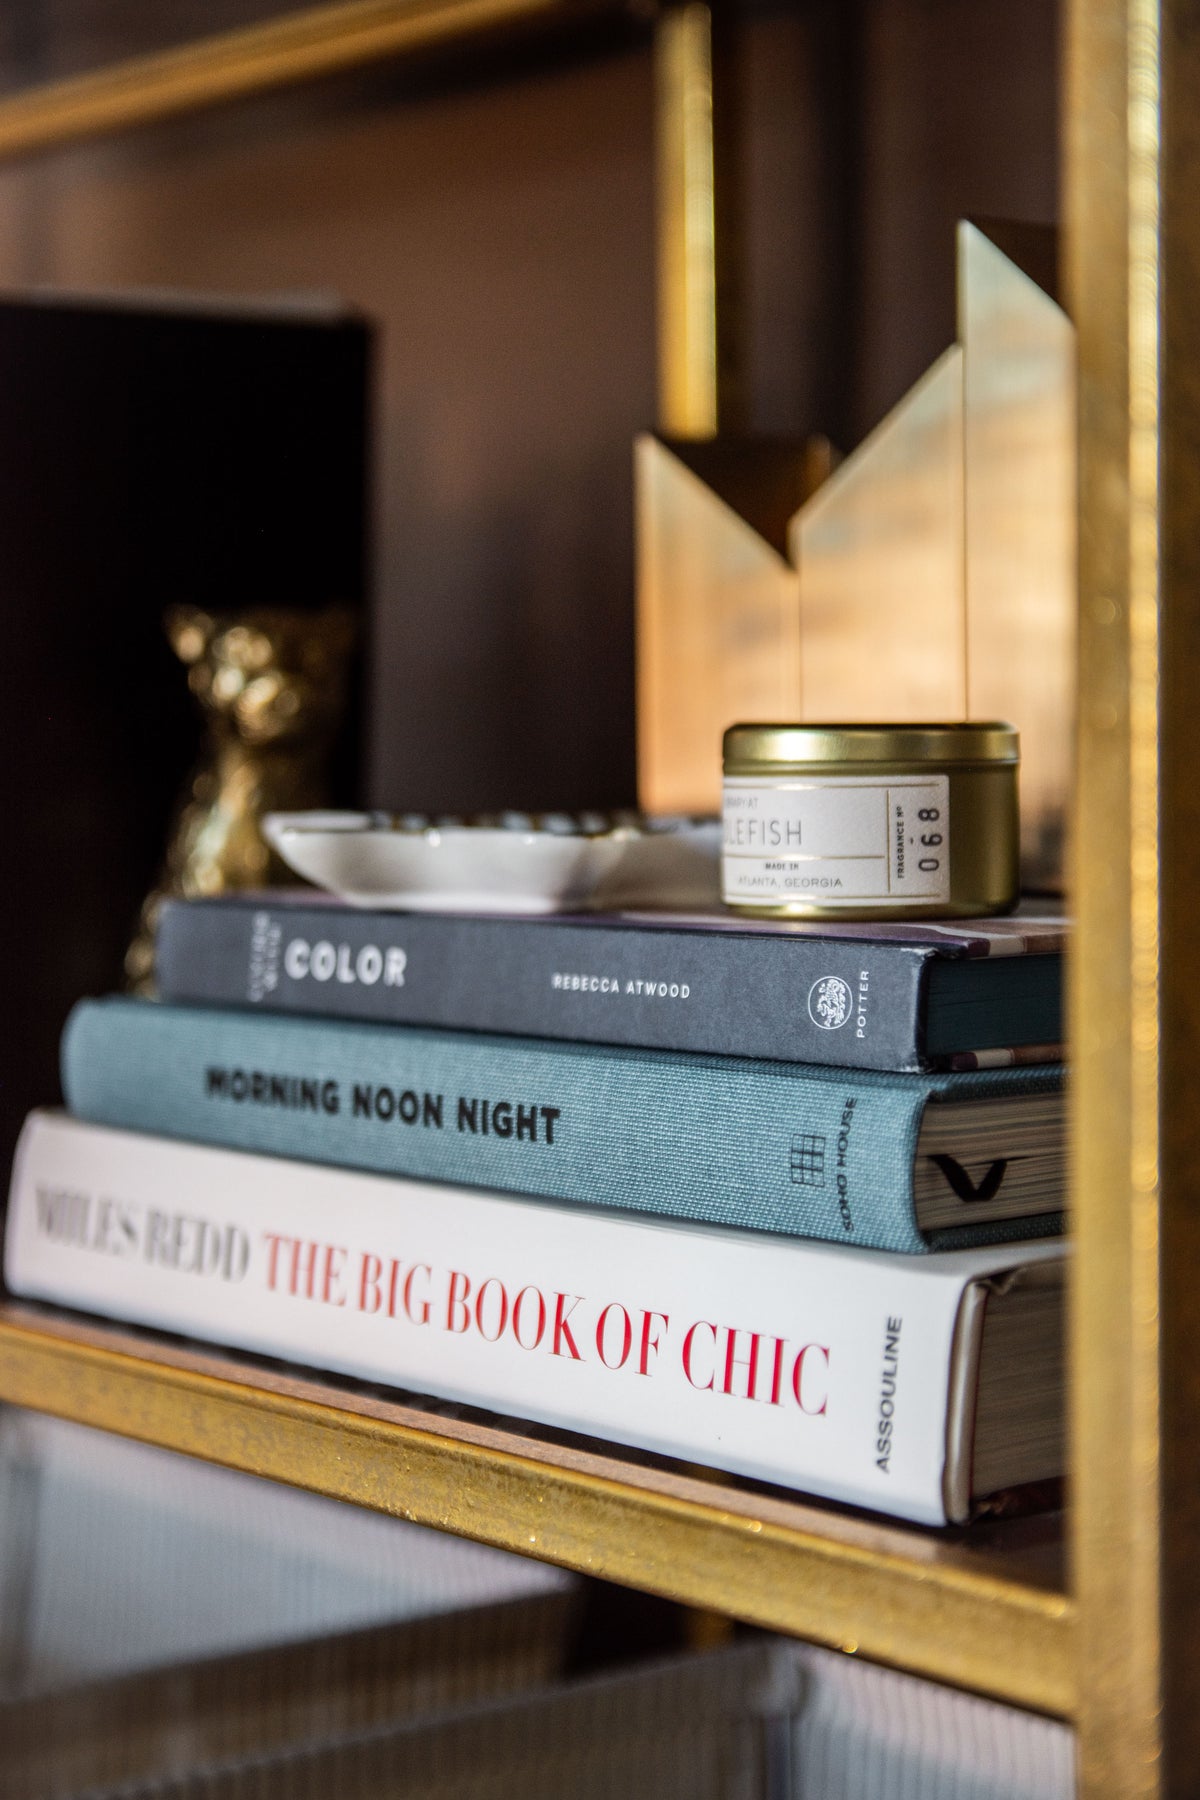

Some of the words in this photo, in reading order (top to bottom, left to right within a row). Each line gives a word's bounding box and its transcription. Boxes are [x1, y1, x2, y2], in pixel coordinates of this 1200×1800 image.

[765, 862, 786, 871] MADE
[790, 862, 799, 871] IN
[896, 821, 905, 879] FRAGRANCE
[918, 808, 943, 872] 068
[738, 874, 781, 889] ATLANTA,
[784, 877, 843, 889] GEORGIA
[284, 938, 408, 987] COLOR
[551, 973, 620, 994] REBECCA
[626, 980, 691, 999] ATWOOD
[856, 970, 870, 1039] POTTER
[205, 1067, 341, 1115] MORNING
[352, 1083, 444, 1129] NOON
[457, 1097, 561, 1145] NIGHT
[836, 1097, 857, 1167] HOUSE
[144, 1206, 252, 1284] REDD
[263, 1230, 348, 1308] THE
[356, 1251, 433, 1326] BIG
[444, 1269, 587, 1362] BOOK
[595, 1302, 669, 1378] OF
[681, 1319, 831, 1418] CHIC
[874, 1316, 903, 1475] ASSOULINE
